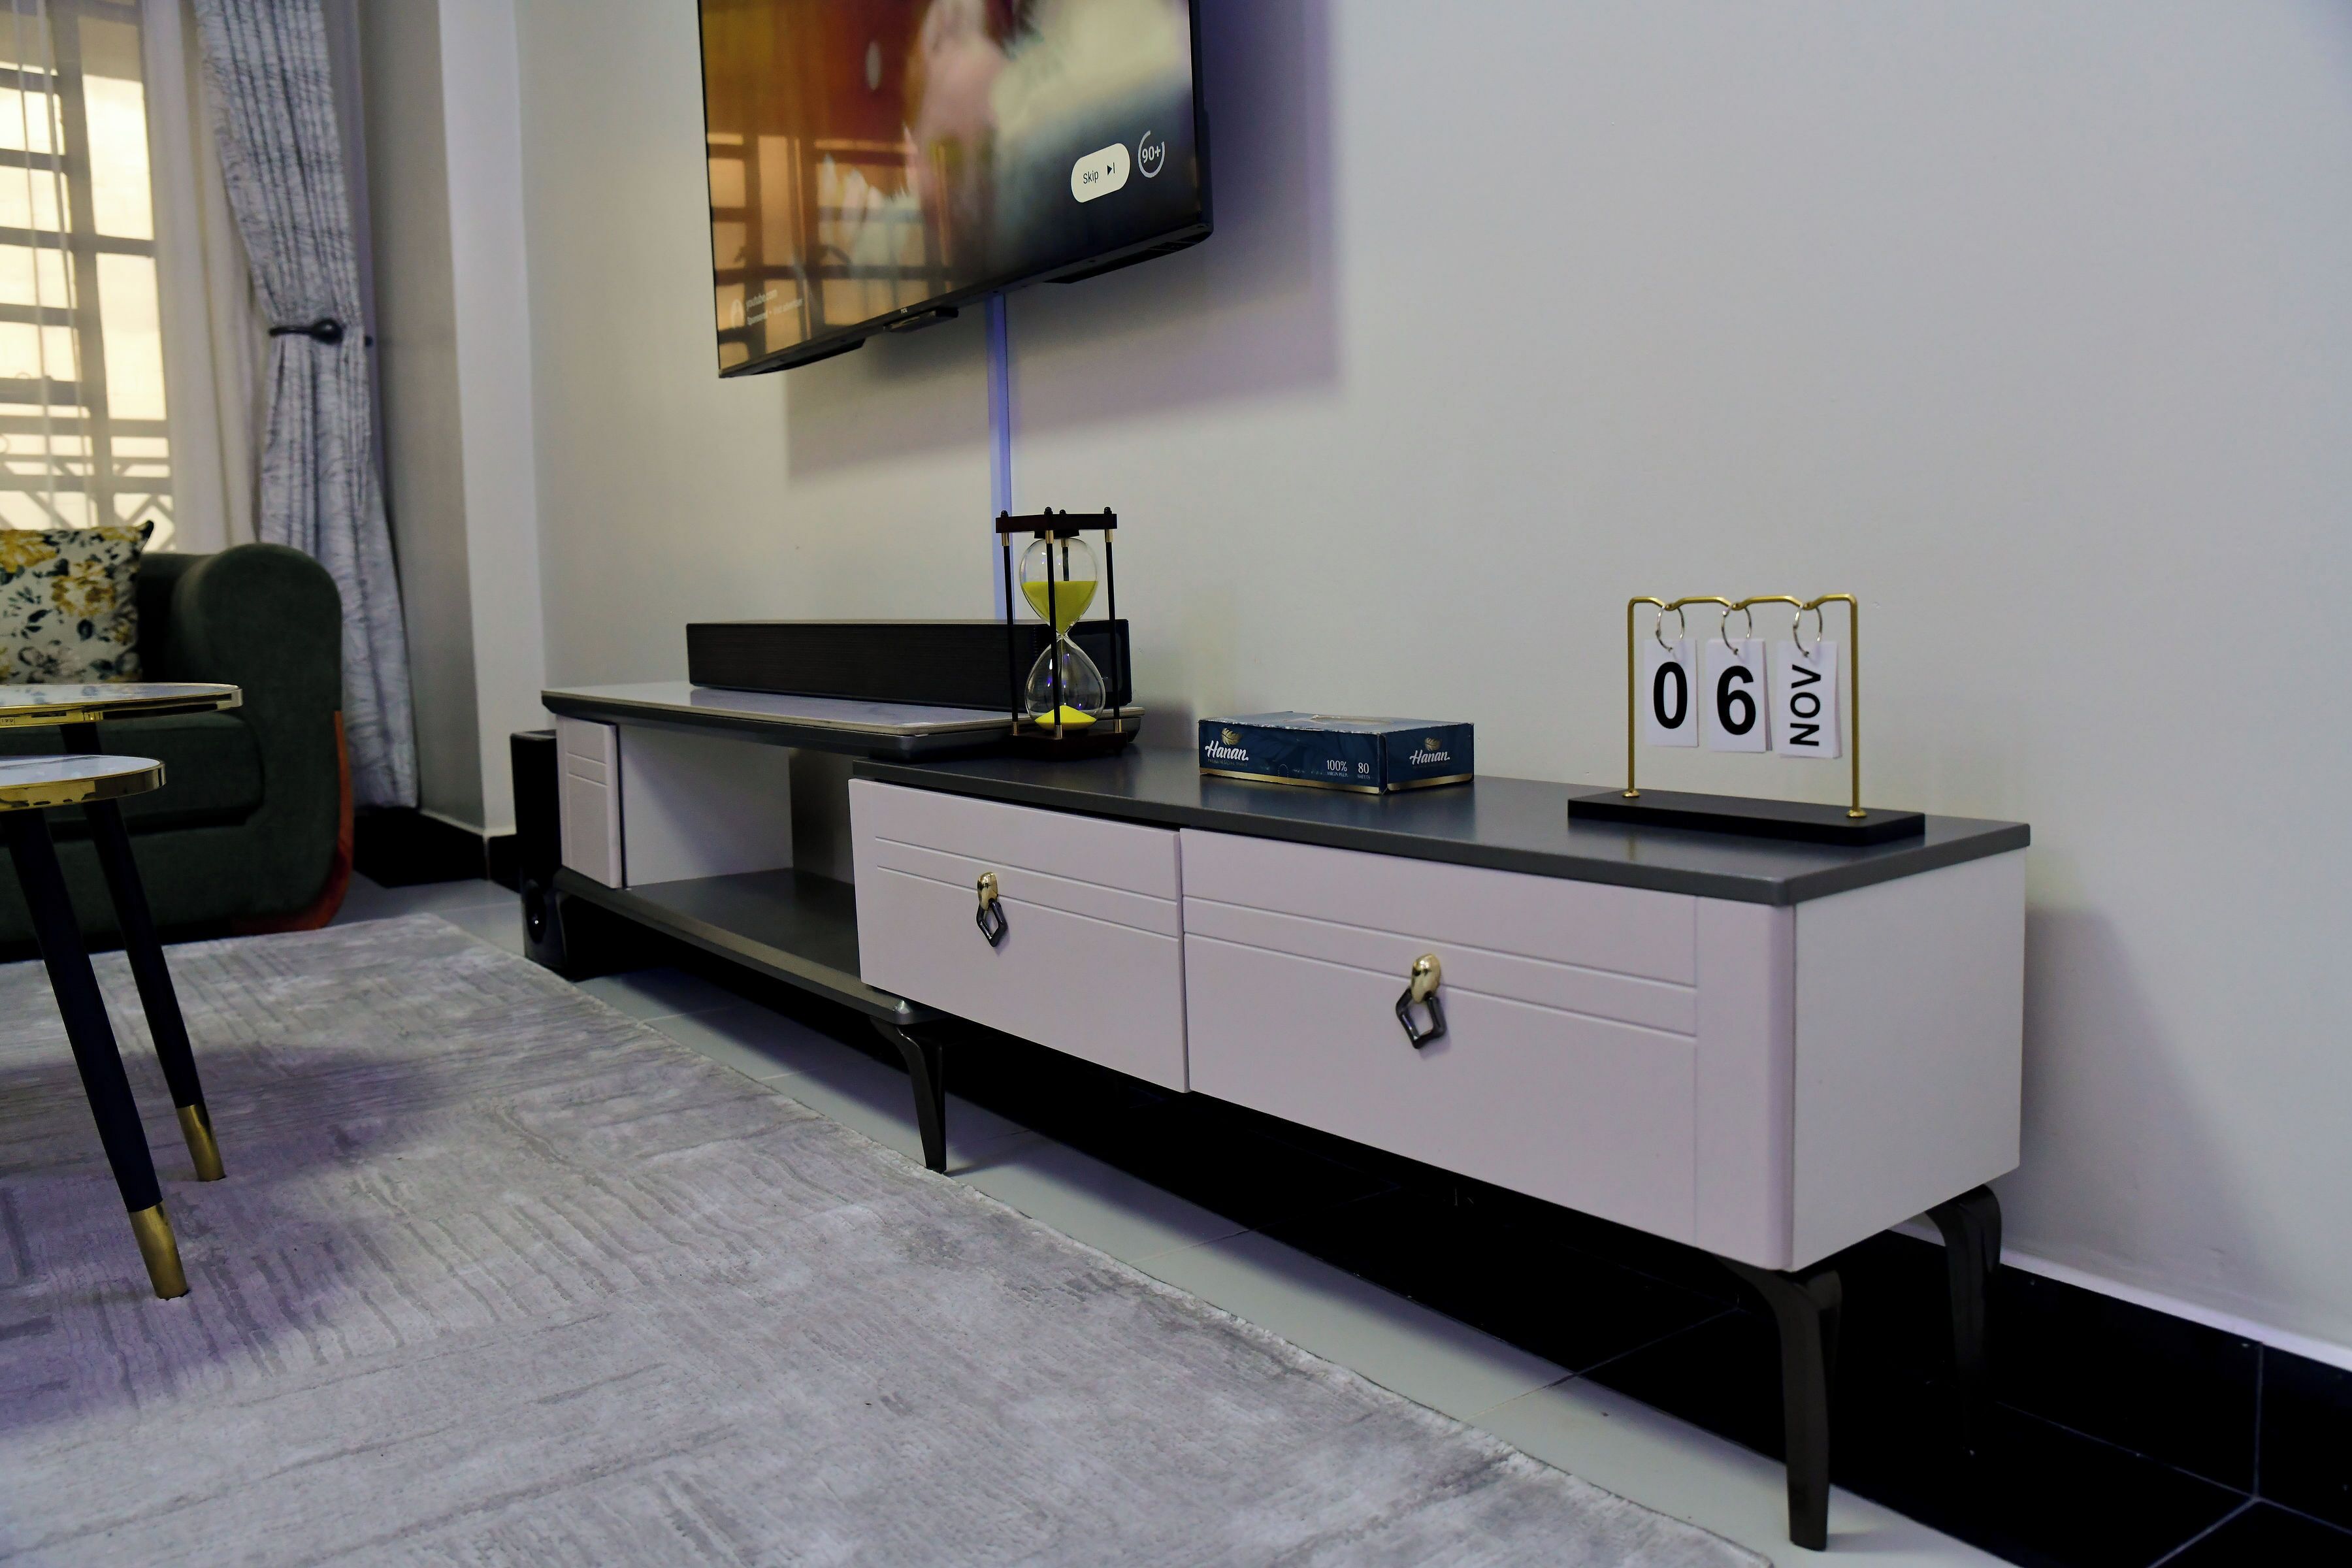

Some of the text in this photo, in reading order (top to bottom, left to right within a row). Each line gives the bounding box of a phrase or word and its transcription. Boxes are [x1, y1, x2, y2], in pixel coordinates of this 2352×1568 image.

[1142, 146, 1161, 163] 90+
[1083, 170, 1099, 184] Skip
[1789, 664, 1821, 746] NOV
[1205, 740, 1249, 761] Hanan
[1409, 749, 1450, 765] Hanan
[1326, 760, 1348, 772] 100%
[1358, 762, 1369, 774] 80
